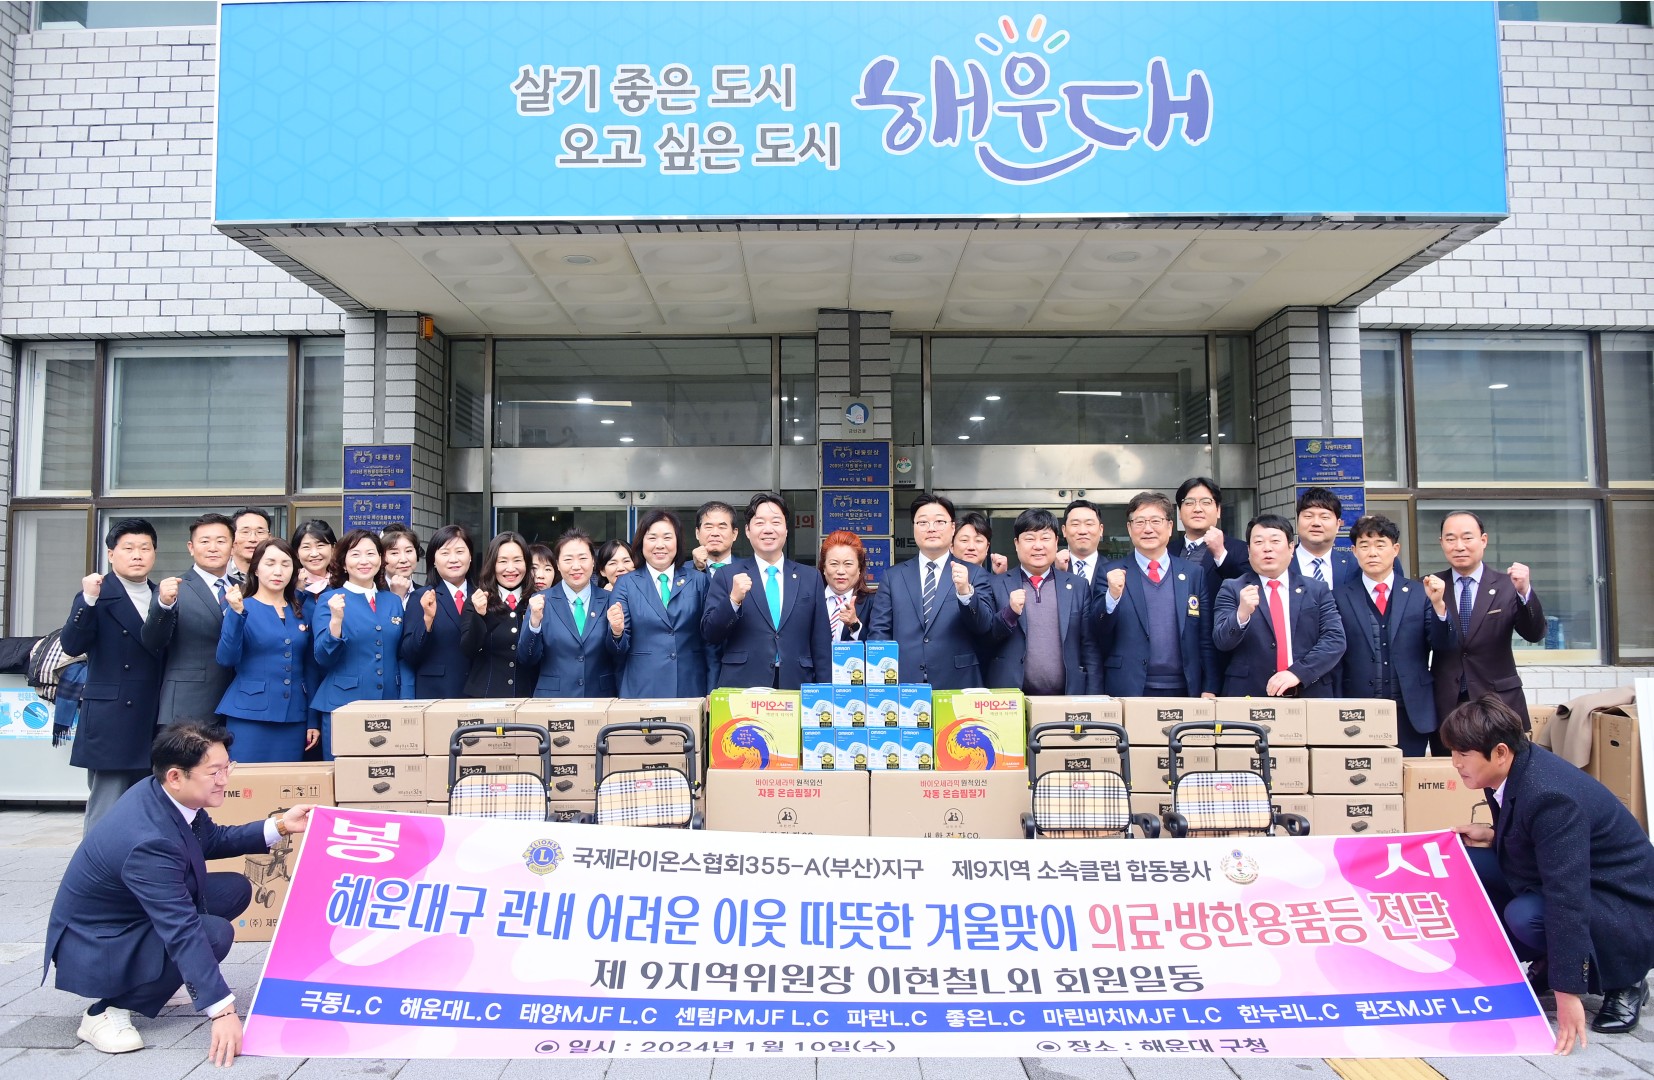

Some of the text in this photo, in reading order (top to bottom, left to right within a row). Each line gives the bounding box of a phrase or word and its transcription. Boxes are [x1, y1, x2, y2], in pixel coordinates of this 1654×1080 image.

[514, 66, 795, 111] 살기 좋은 도시
[559, 125, 840, 171] 오고 싶은 도시
[975, 700, 1017, 714] 바이오스톤
[758, 788, 821, 798] 자동 온습찜질기
[920, 779, 959, 787] 바이오세라믹
[923, 788, 986, 798] 자동 온습찜질기
[326, 818, 401, 863] 봉
[533, 839, 558, 849] LIONS
[572, 846, 1212, 883] 국제라이온스협회355-A(부산)지구 제9지역 소속클럽 합동봉사
[1374, 842, 1450, 880] 사
[328, 876, 488, 934] 해운대구
[496, 890, 576, 940] 관내
[587, 893, 700, 946] 어려운
[713, 898, 786, 948] 이웃
[800, 901, 914, 950] 따뜻한
[925, 902, 1078, 952] 겨울맞이
[1370, 894, 1458, 940] 전달
[590, 960, 1205, 996] 제 9지역위원장 이현철L외 회원일동
[300, 990, 1493, 1027] 극동L.C 해운대L.C 태양MJF L.C 센텀PMJF L.C 파란L.C 좋은L.C 마린비치MJF L.C 한누리L.C 퀸즈MJF L.C
[568, 1040, 616, 1054] 일시
[641, 1040, 734, 1053] 2024년
[744, 1040, 784, 1053] 1월
[794, 1040, 897, 1054] 10일(수)
[1067, 1040, 1118, 1053] 장소
[1140, 1038, 1214, 1053] 해운대
[1219, 1038, 1270, 1054] 구청
